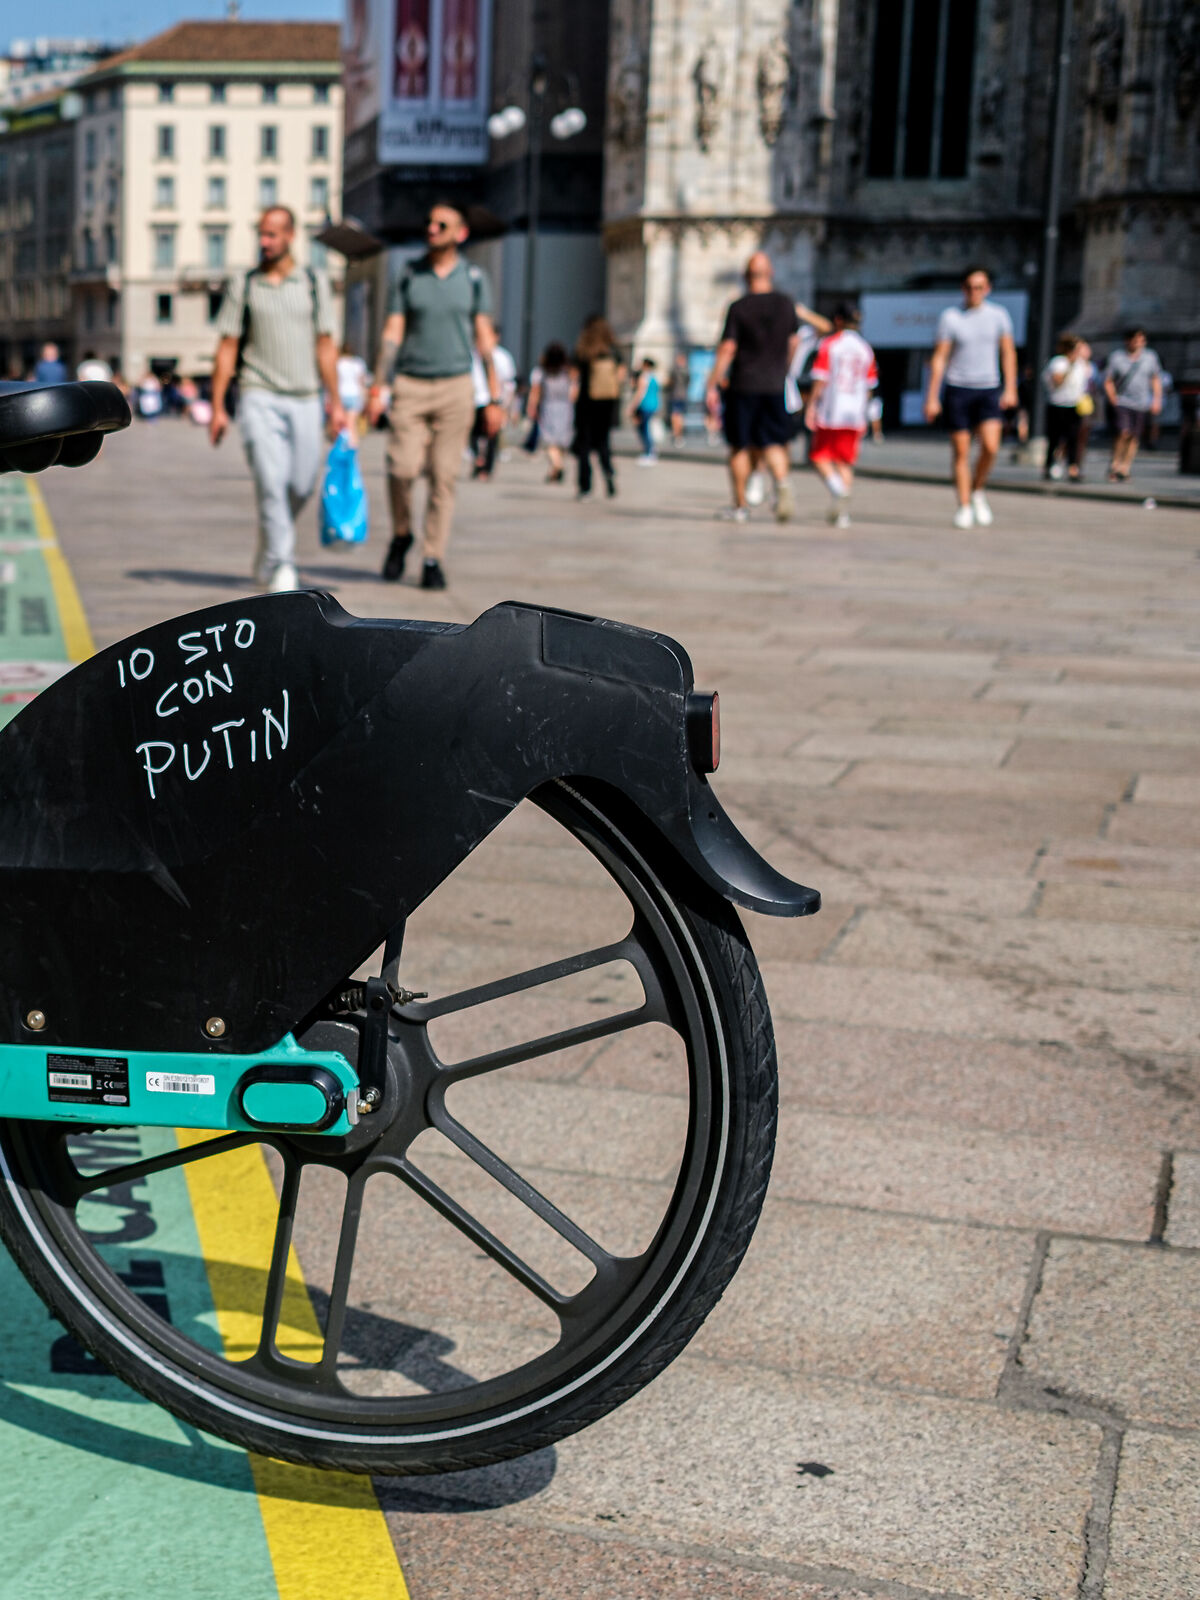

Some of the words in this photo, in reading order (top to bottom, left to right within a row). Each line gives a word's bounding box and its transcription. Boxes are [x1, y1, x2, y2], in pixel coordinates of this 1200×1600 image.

[178, 619, 255, 664] STO
[156, 663, 233, 717] CON
[136, 689, 289, 799] PUTIN
